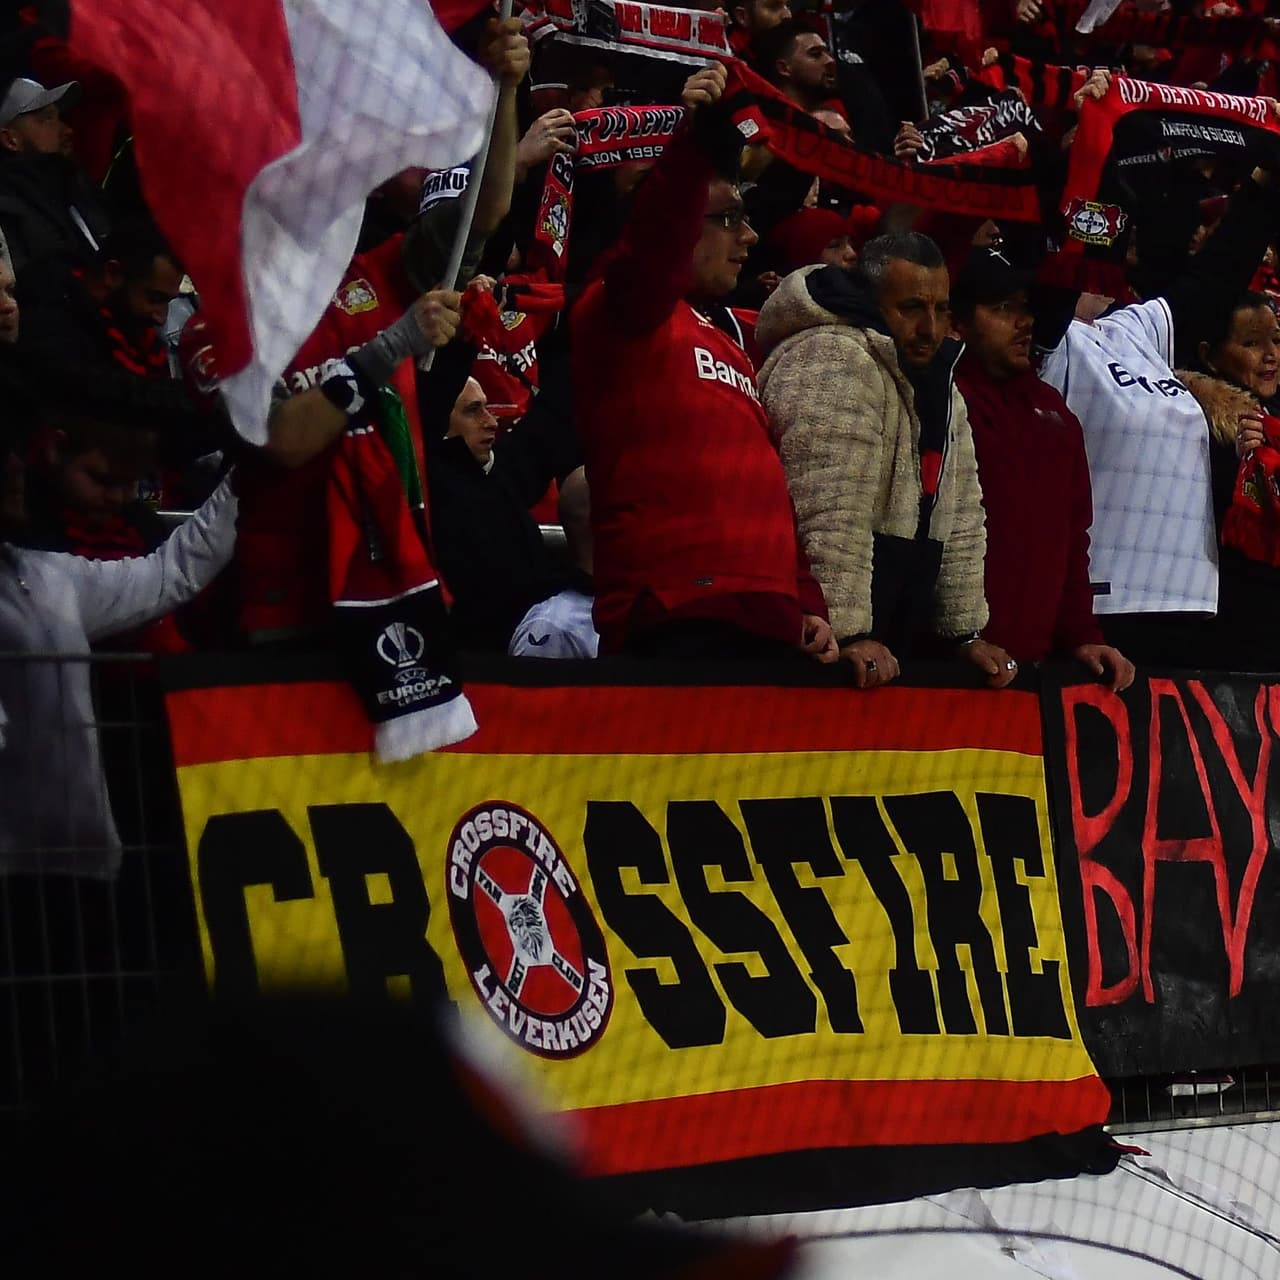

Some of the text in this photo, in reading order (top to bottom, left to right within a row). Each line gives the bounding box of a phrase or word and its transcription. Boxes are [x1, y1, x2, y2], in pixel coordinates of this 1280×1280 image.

[376, 674, 453, 705] EUROPA
[450, 808, 577, 900] CROSSFIRE
[473, 957, 610, 1051] LEVERKUSEN
